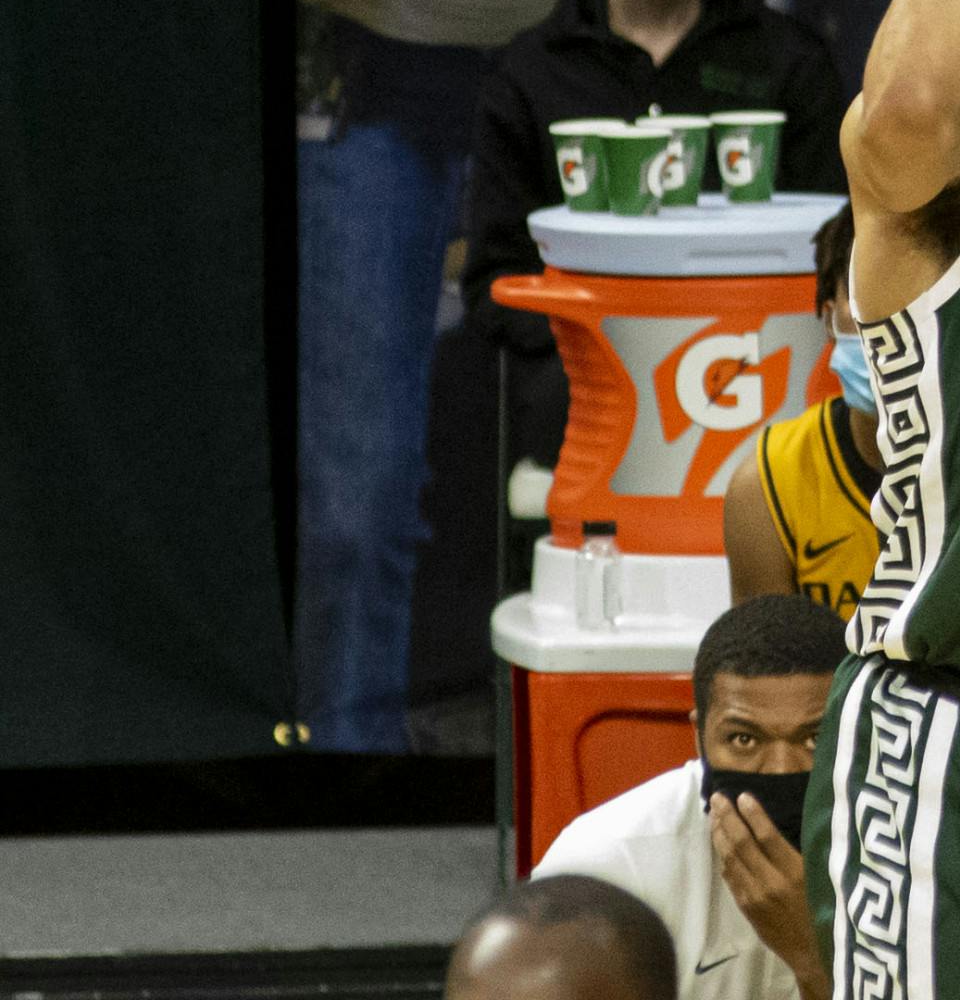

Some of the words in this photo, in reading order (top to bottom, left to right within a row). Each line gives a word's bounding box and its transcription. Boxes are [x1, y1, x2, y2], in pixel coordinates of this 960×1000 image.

[557, 147, 588, 196] G
[719, 137, 753, 187] G
[675, 332, 763, 431] G
